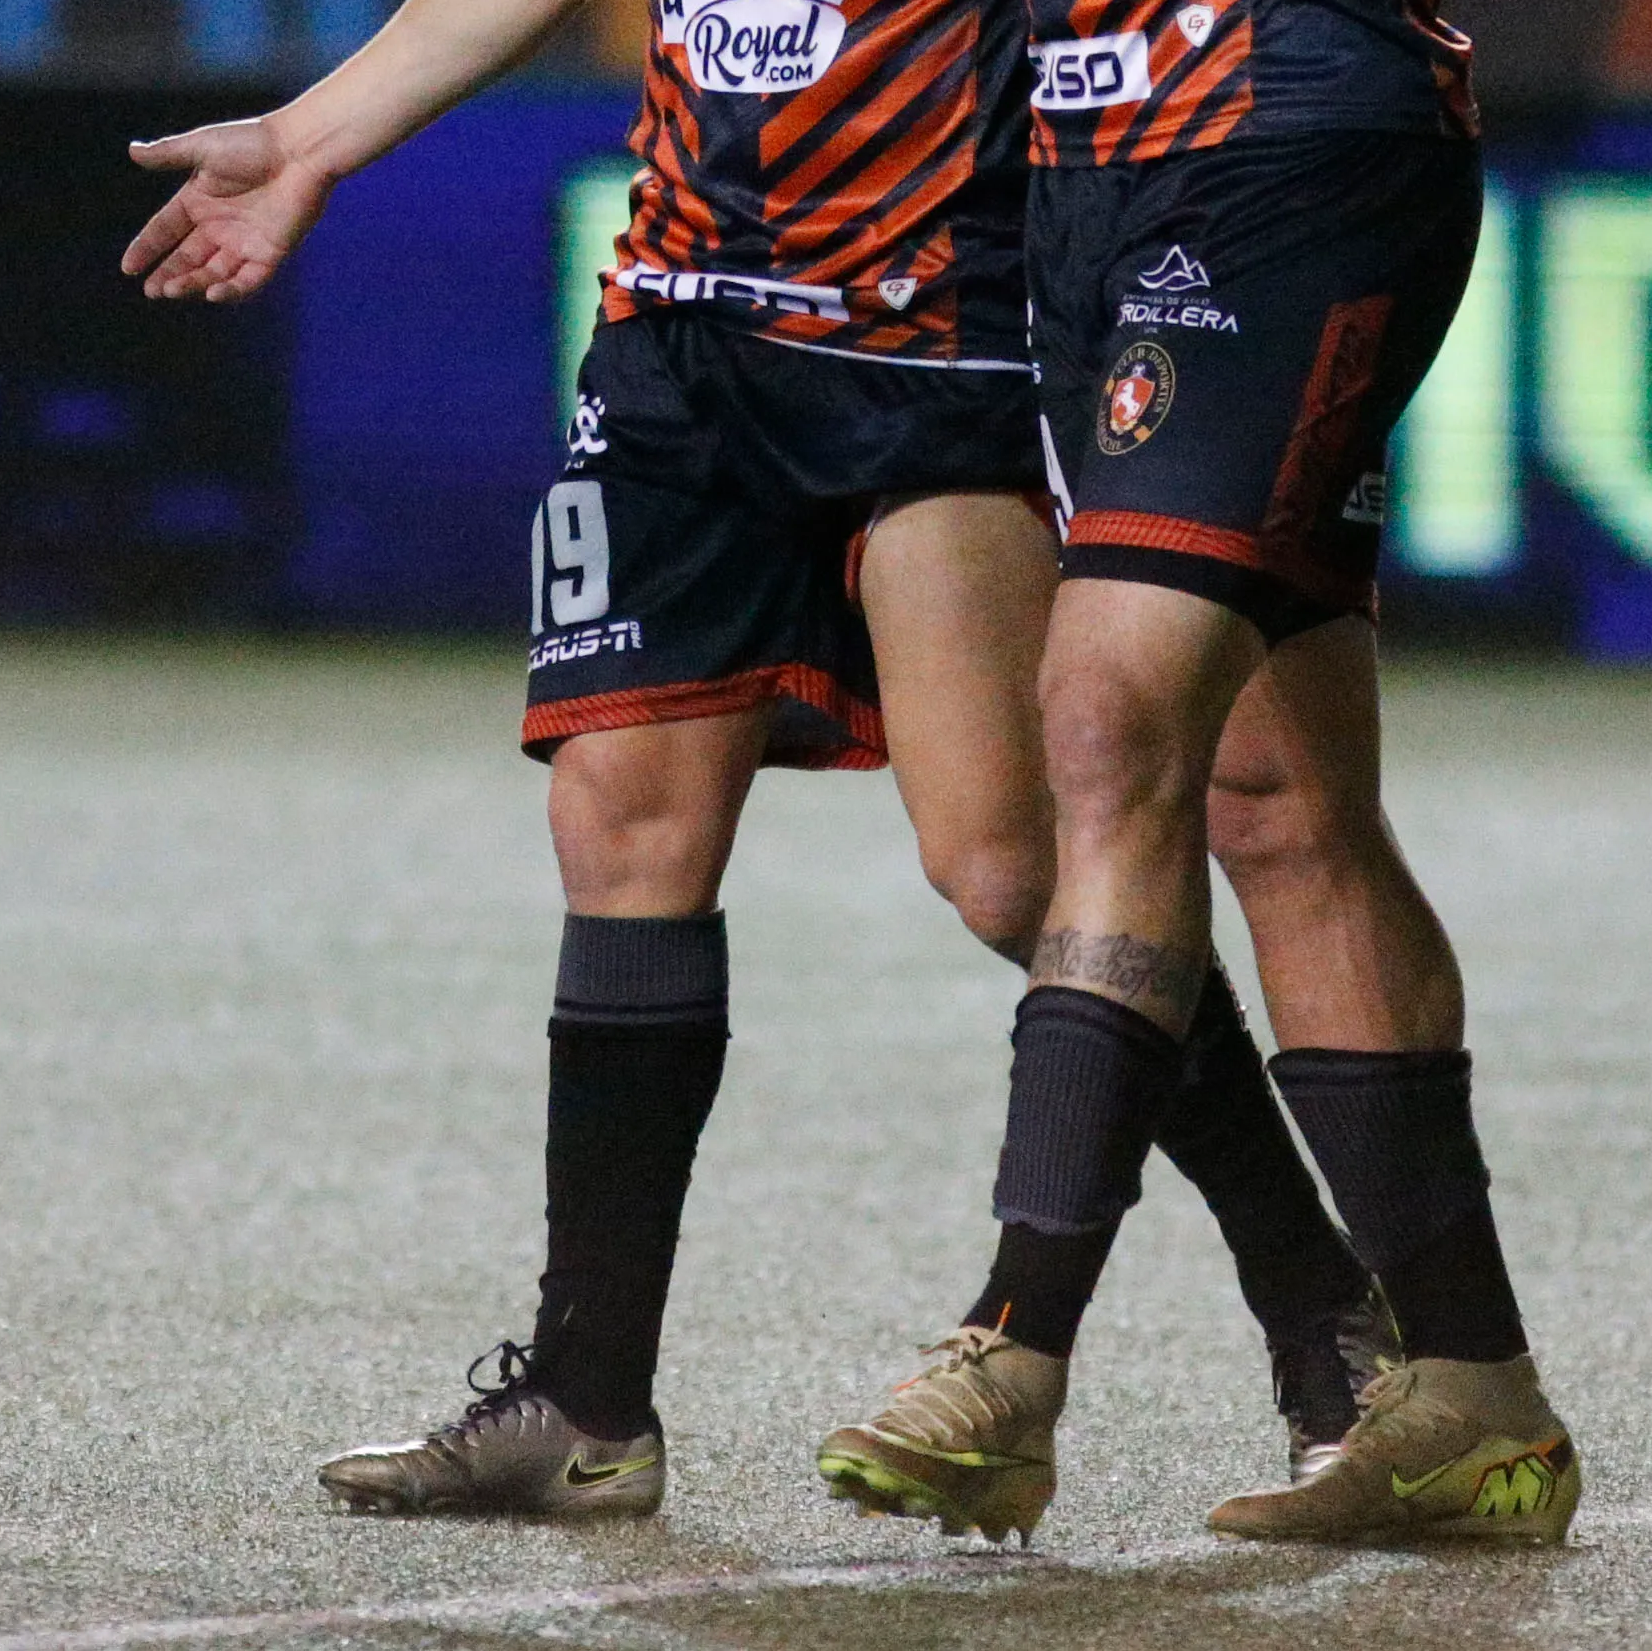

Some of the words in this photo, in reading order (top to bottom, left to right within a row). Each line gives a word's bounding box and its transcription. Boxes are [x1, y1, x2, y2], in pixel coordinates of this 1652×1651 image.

[693, 4, 821, 88] Royal
[765, 63, 814, 84] .COM
[1117, 302, 1239, 334] RDILLERA
